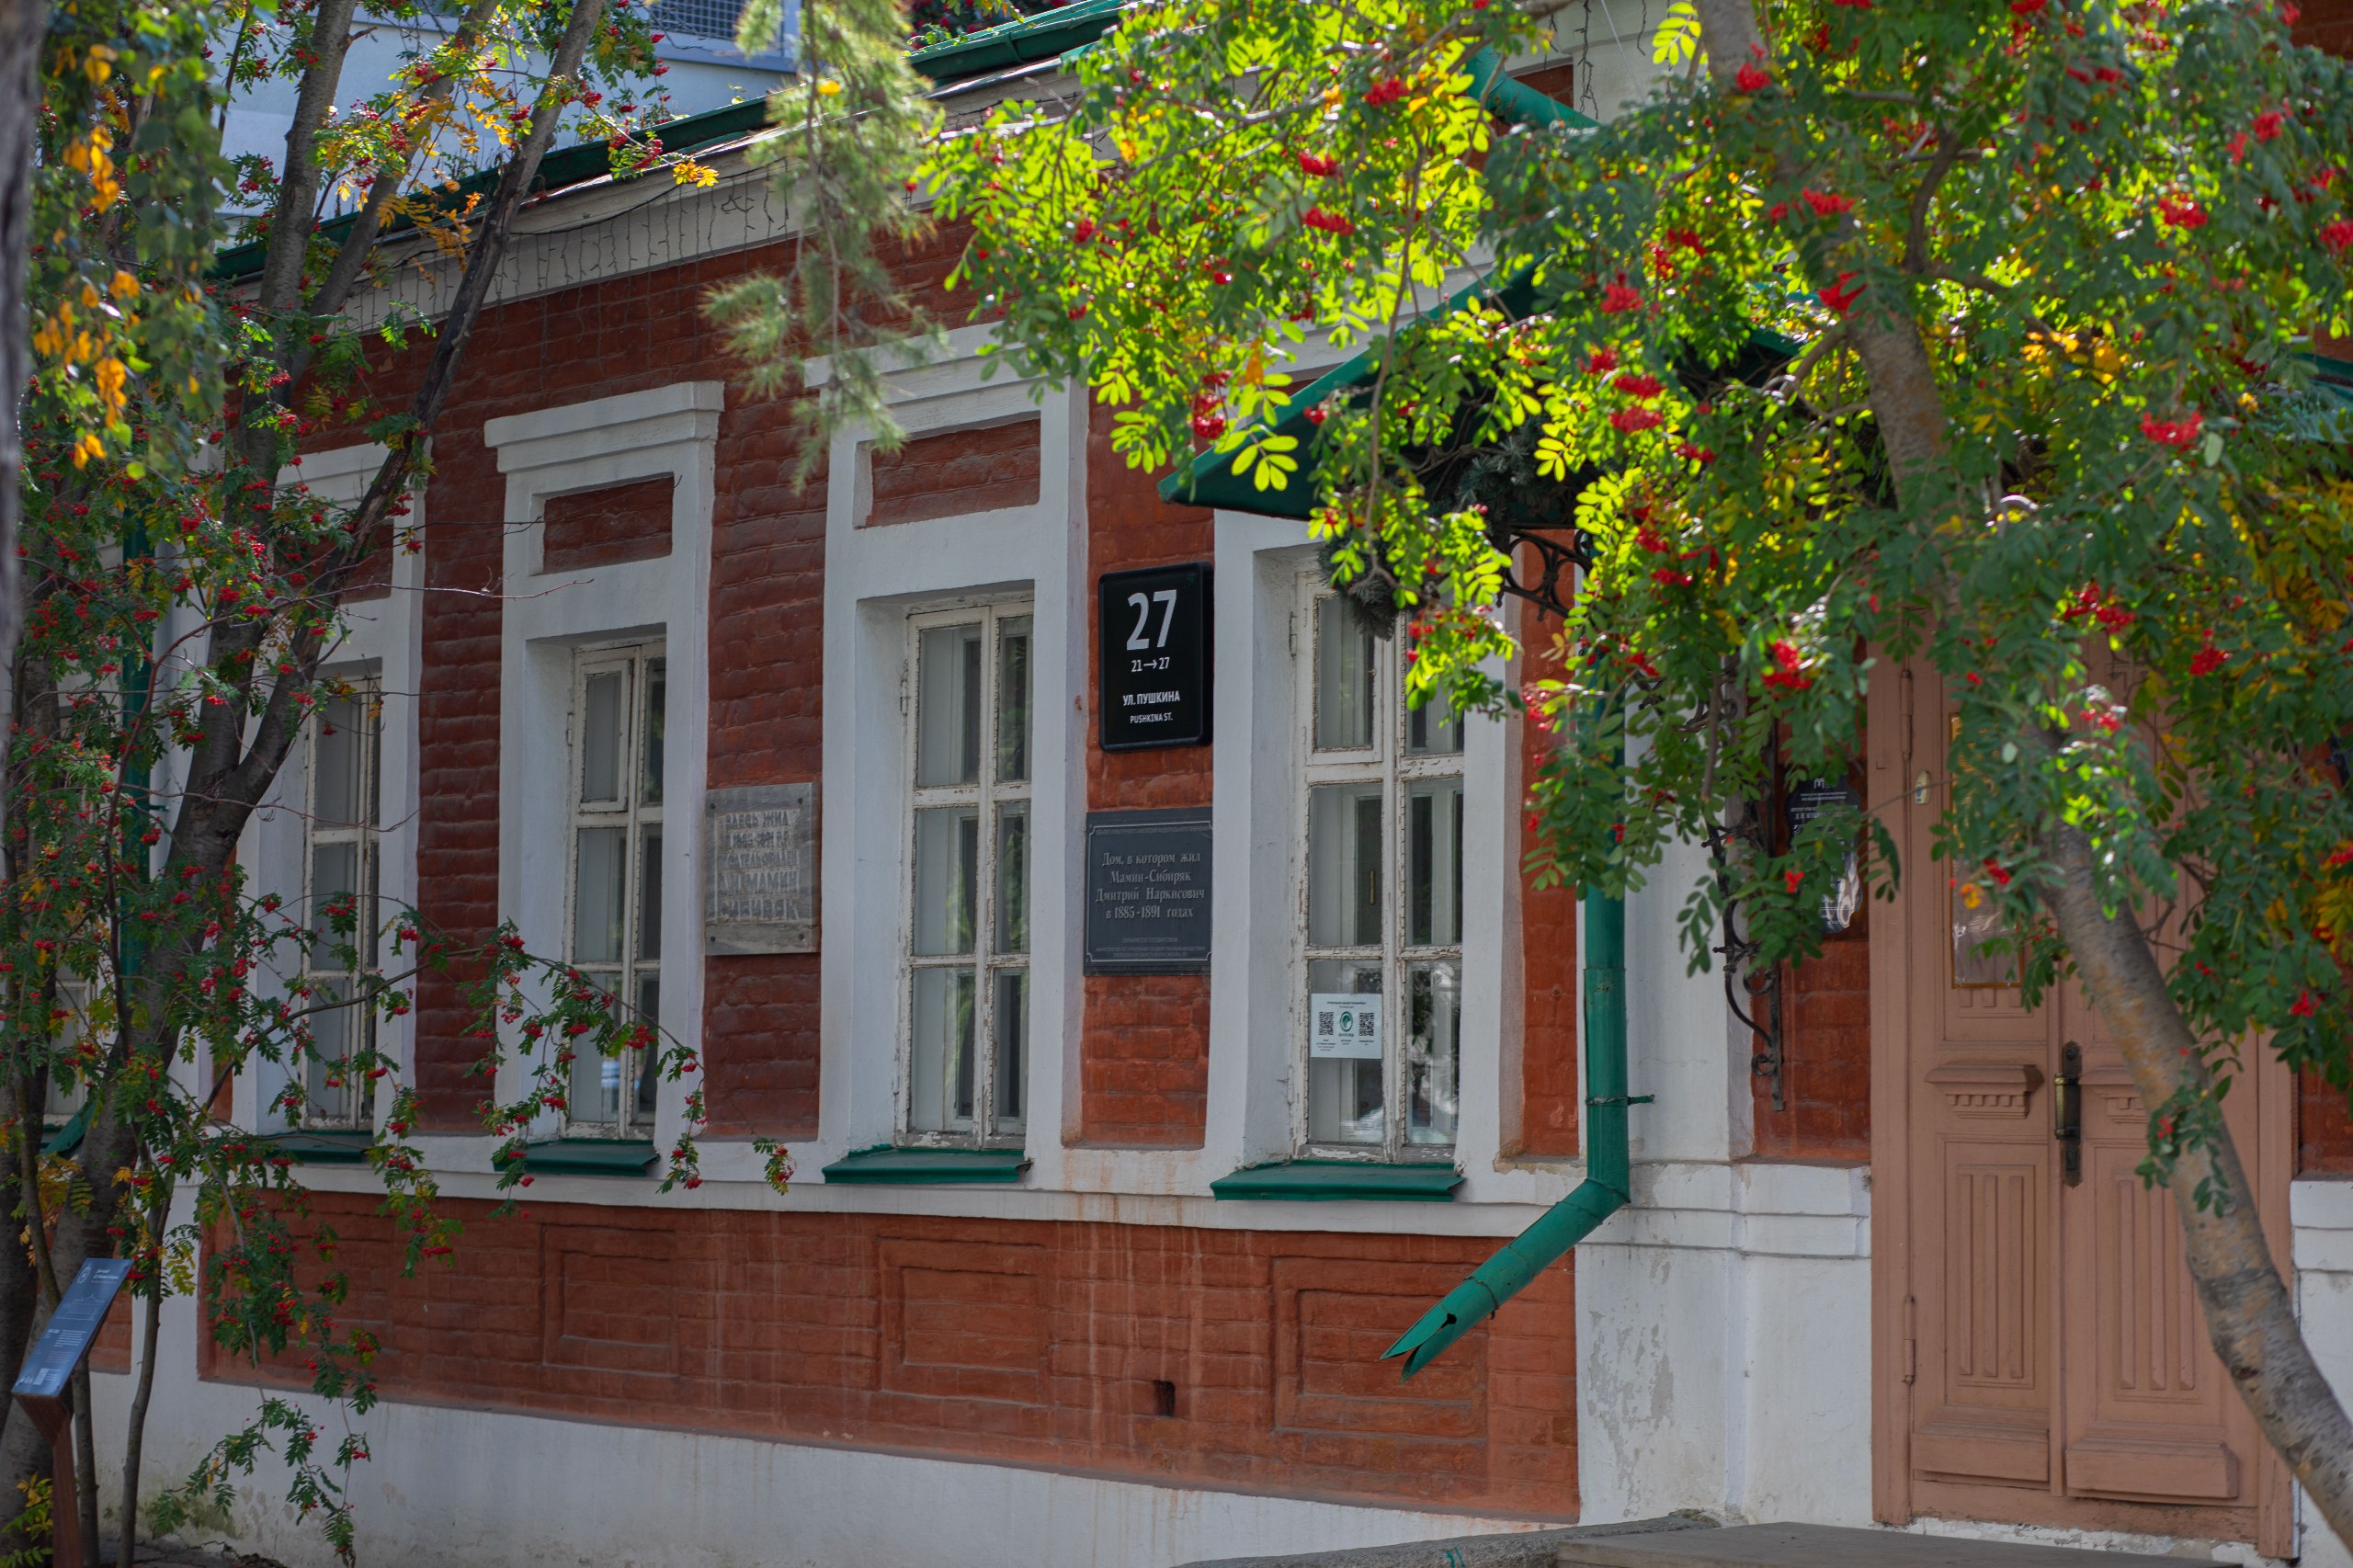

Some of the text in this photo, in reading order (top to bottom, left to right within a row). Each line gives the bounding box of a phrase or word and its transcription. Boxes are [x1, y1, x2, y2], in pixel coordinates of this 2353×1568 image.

[1126, 589, 1177, 651] 27
[1131, 656, 1170, 673] 21 27
[1122, 690, 1180, 707] УЛ. ПУШКИНА
[1130, 713, 1163, 724] PUSHKINA
[725, 811, 790, 829] ЗДЕСЬ ЖИЛ
[1101, 852, 1201, 867] Дом, в котором жил
[1110, 869, 1191, 885] Мамин-Сибиряк
[1096, 887, 1206, 903] Дмитрий Наркисович
[1106, 905, 1194, 919] в 1885-1891 годах
